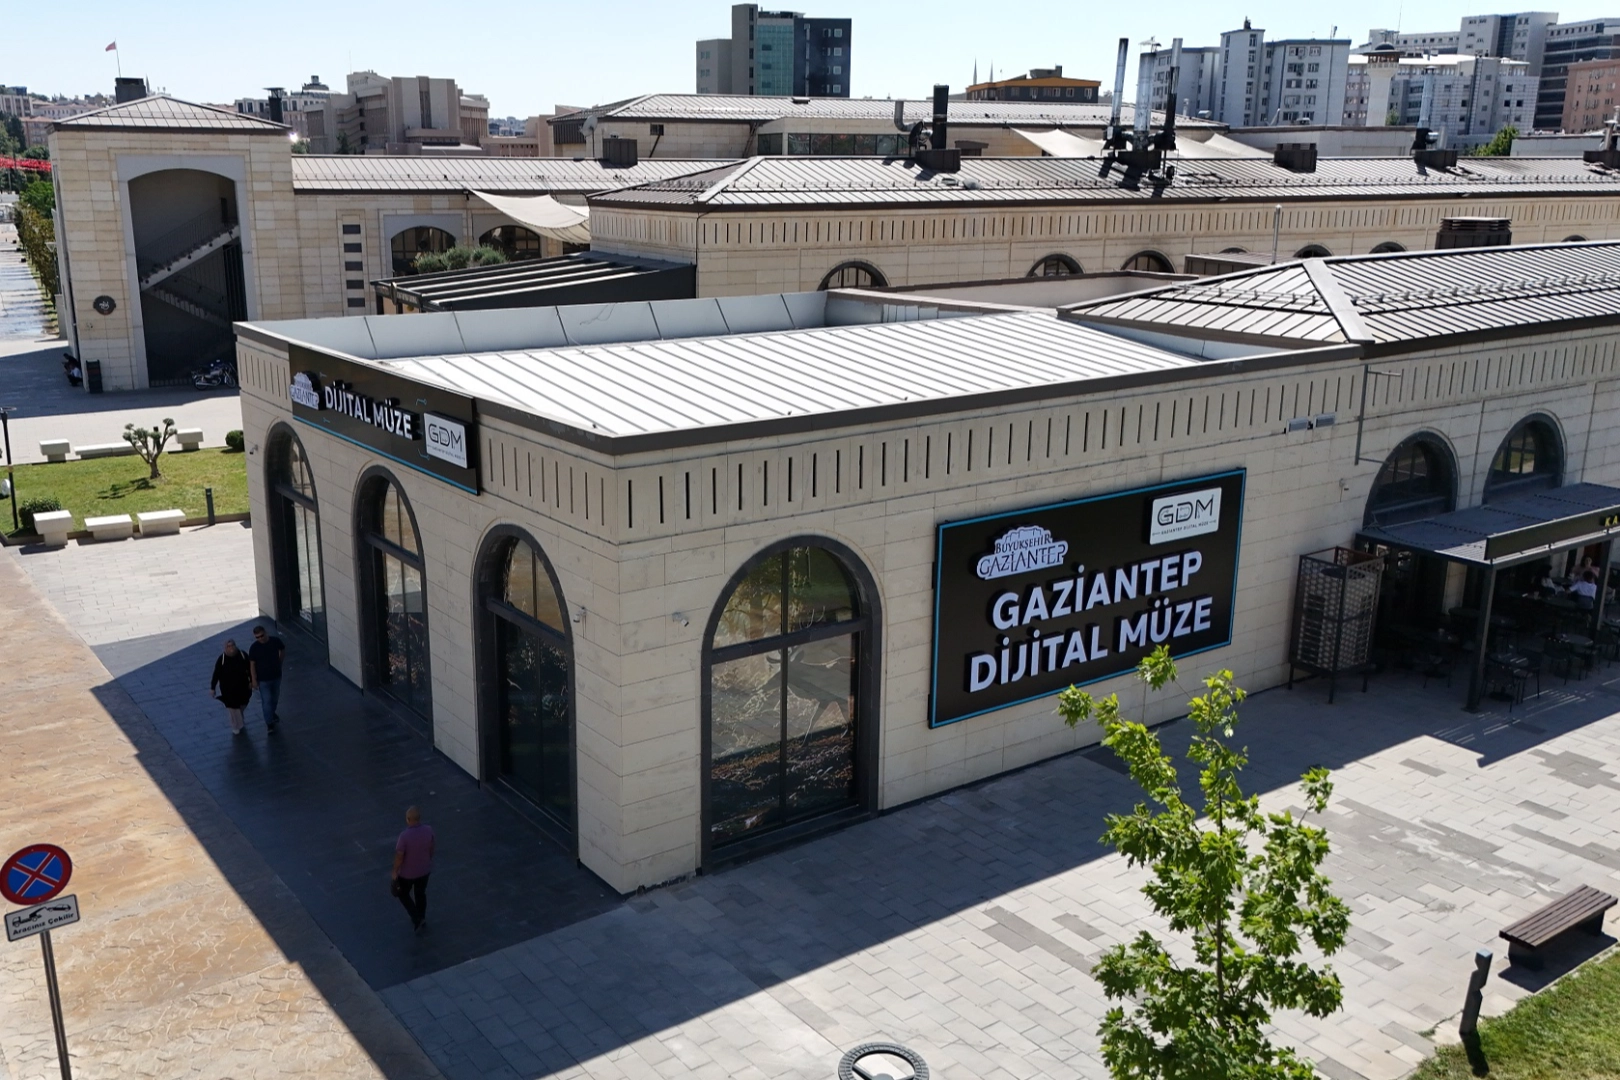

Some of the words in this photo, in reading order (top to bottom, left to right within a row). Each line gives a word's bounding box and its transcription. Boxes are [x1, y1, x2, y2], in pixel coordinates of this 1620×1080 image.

[324, 381, 371, 424] DİJİTAL
[372, 398, 413, 441] MÜZE
[428, 423, 463, 452] GDM
[1157, 495, 1214, 526] GDM
[979, 544, 1066, 577] GAZİANTEP
[992, 551, 1203, 630] GAZİANTEP
[969, 626, 1108, 693] DİJİTAL
[1118, 597, 1214, 653] MÜZE
[47, 912, 75, 925] Çekilir
